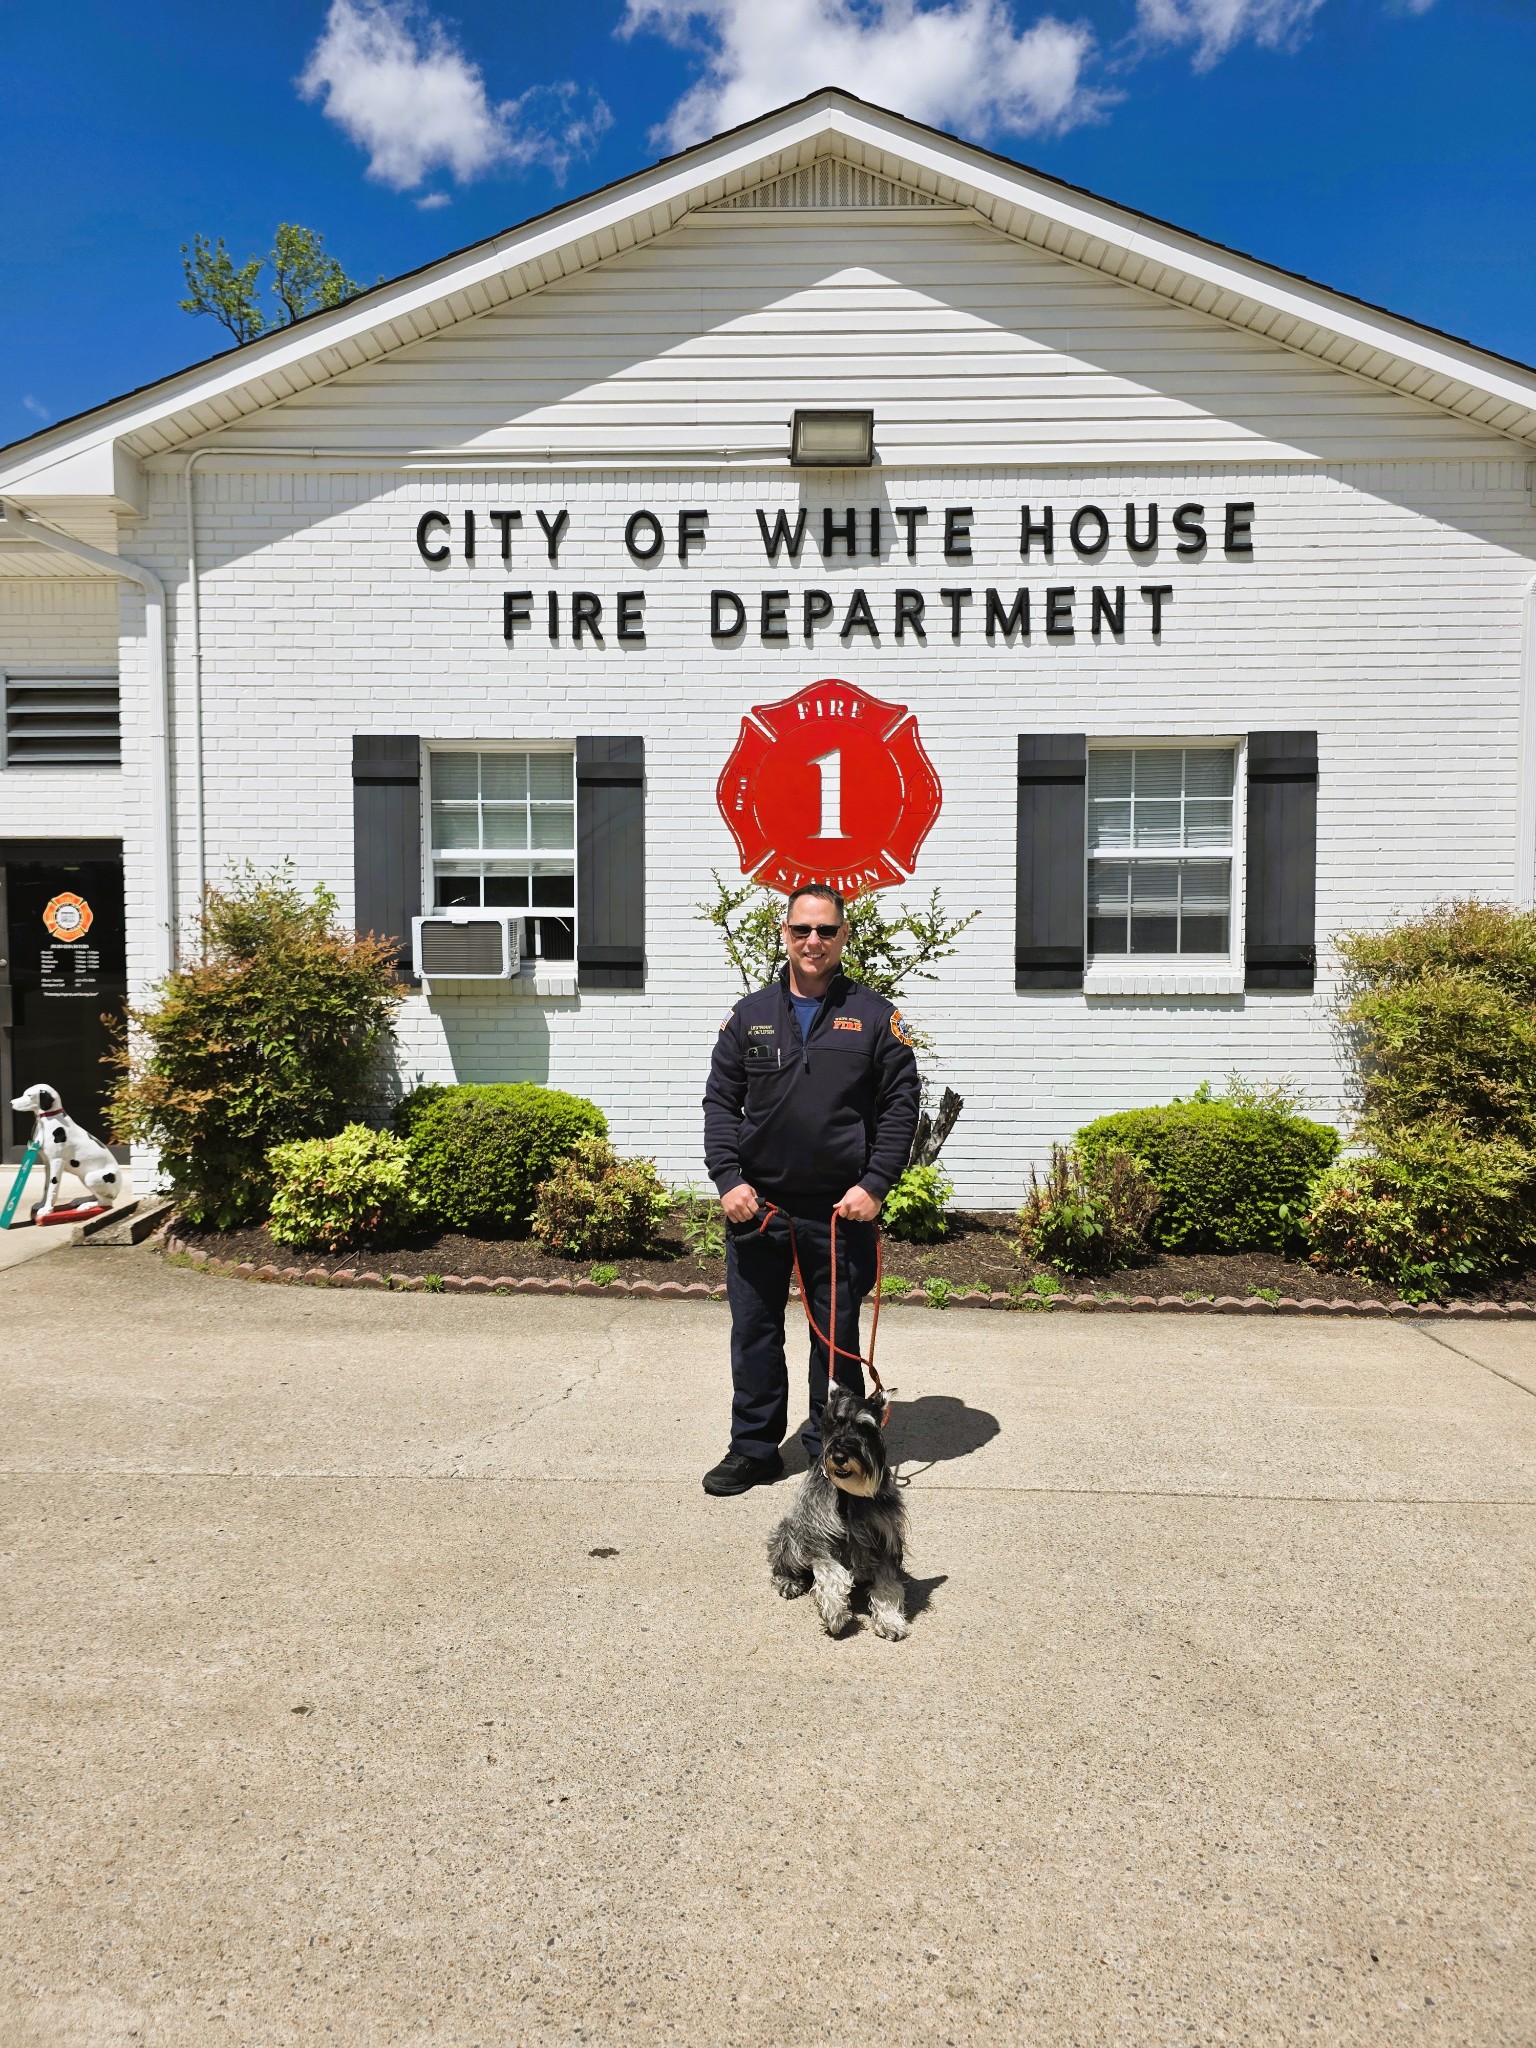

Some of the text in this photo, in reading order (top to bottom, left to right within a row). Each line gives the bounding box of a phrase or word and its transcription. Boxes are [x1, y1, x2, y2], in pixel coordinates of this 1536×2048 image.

[416, 501, 1255, 562] CITY OF WHITE HOUSE
[503, 584, 1173, 641] FIRE DEPARTMENT
[796, 698, 866, 720] FIRE
[806, 747, 852, 839] 1
[832, 1020, 863, 1032] FIRE
